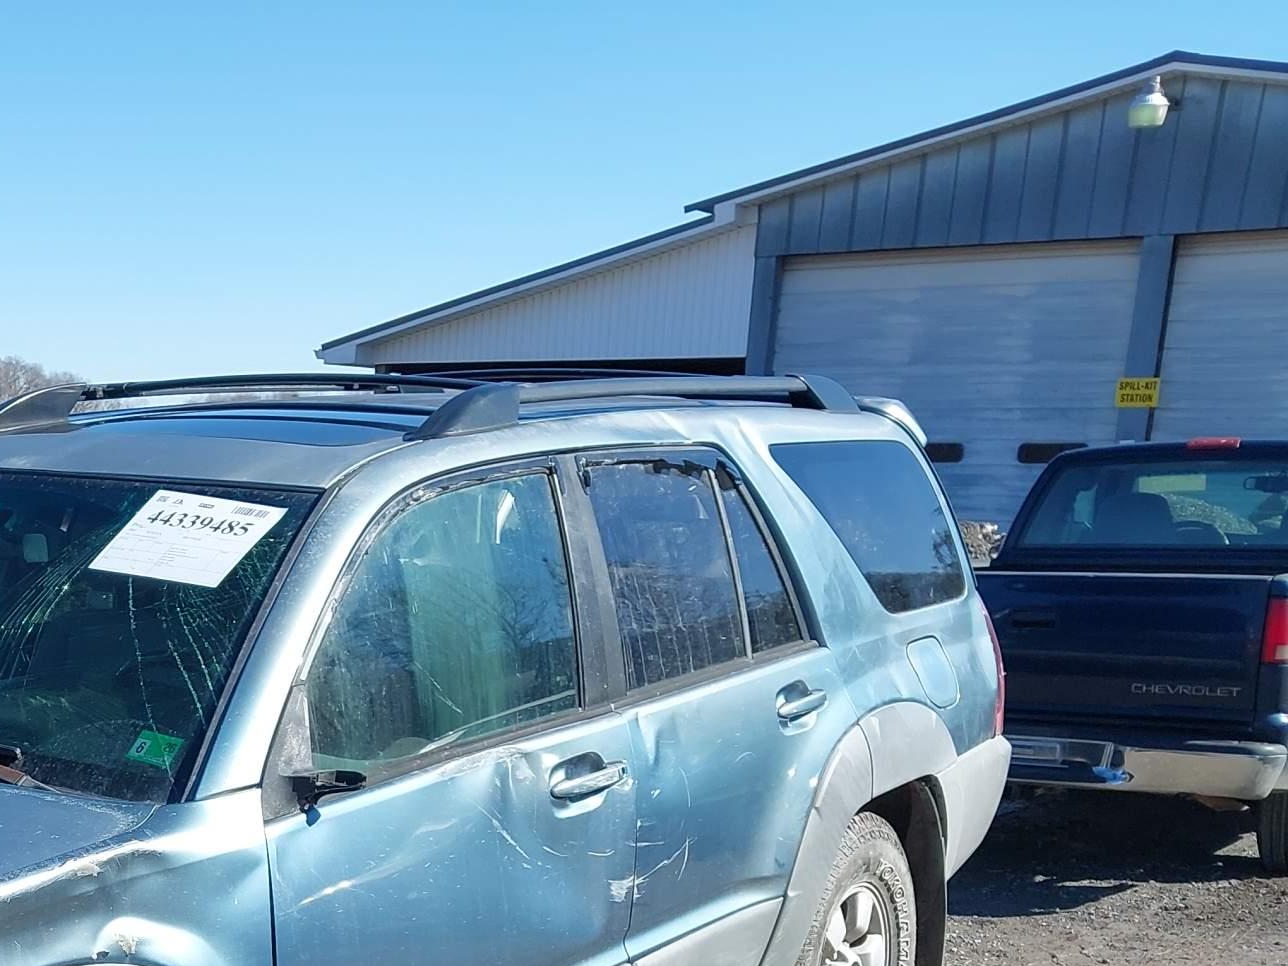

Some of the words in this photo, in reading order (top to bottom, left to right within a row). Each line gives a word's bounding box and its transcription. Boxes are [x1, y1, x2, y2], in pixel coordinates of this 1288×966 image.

[1119, 381, 1158, 391] SPILL-KIT
[1119, 393, 1154, 403] STATION
[147, 510, 255, 536] 44339485
[1131, 683, 1243, 697] CHEVROLET
[135, 741, 147, 754] 6
